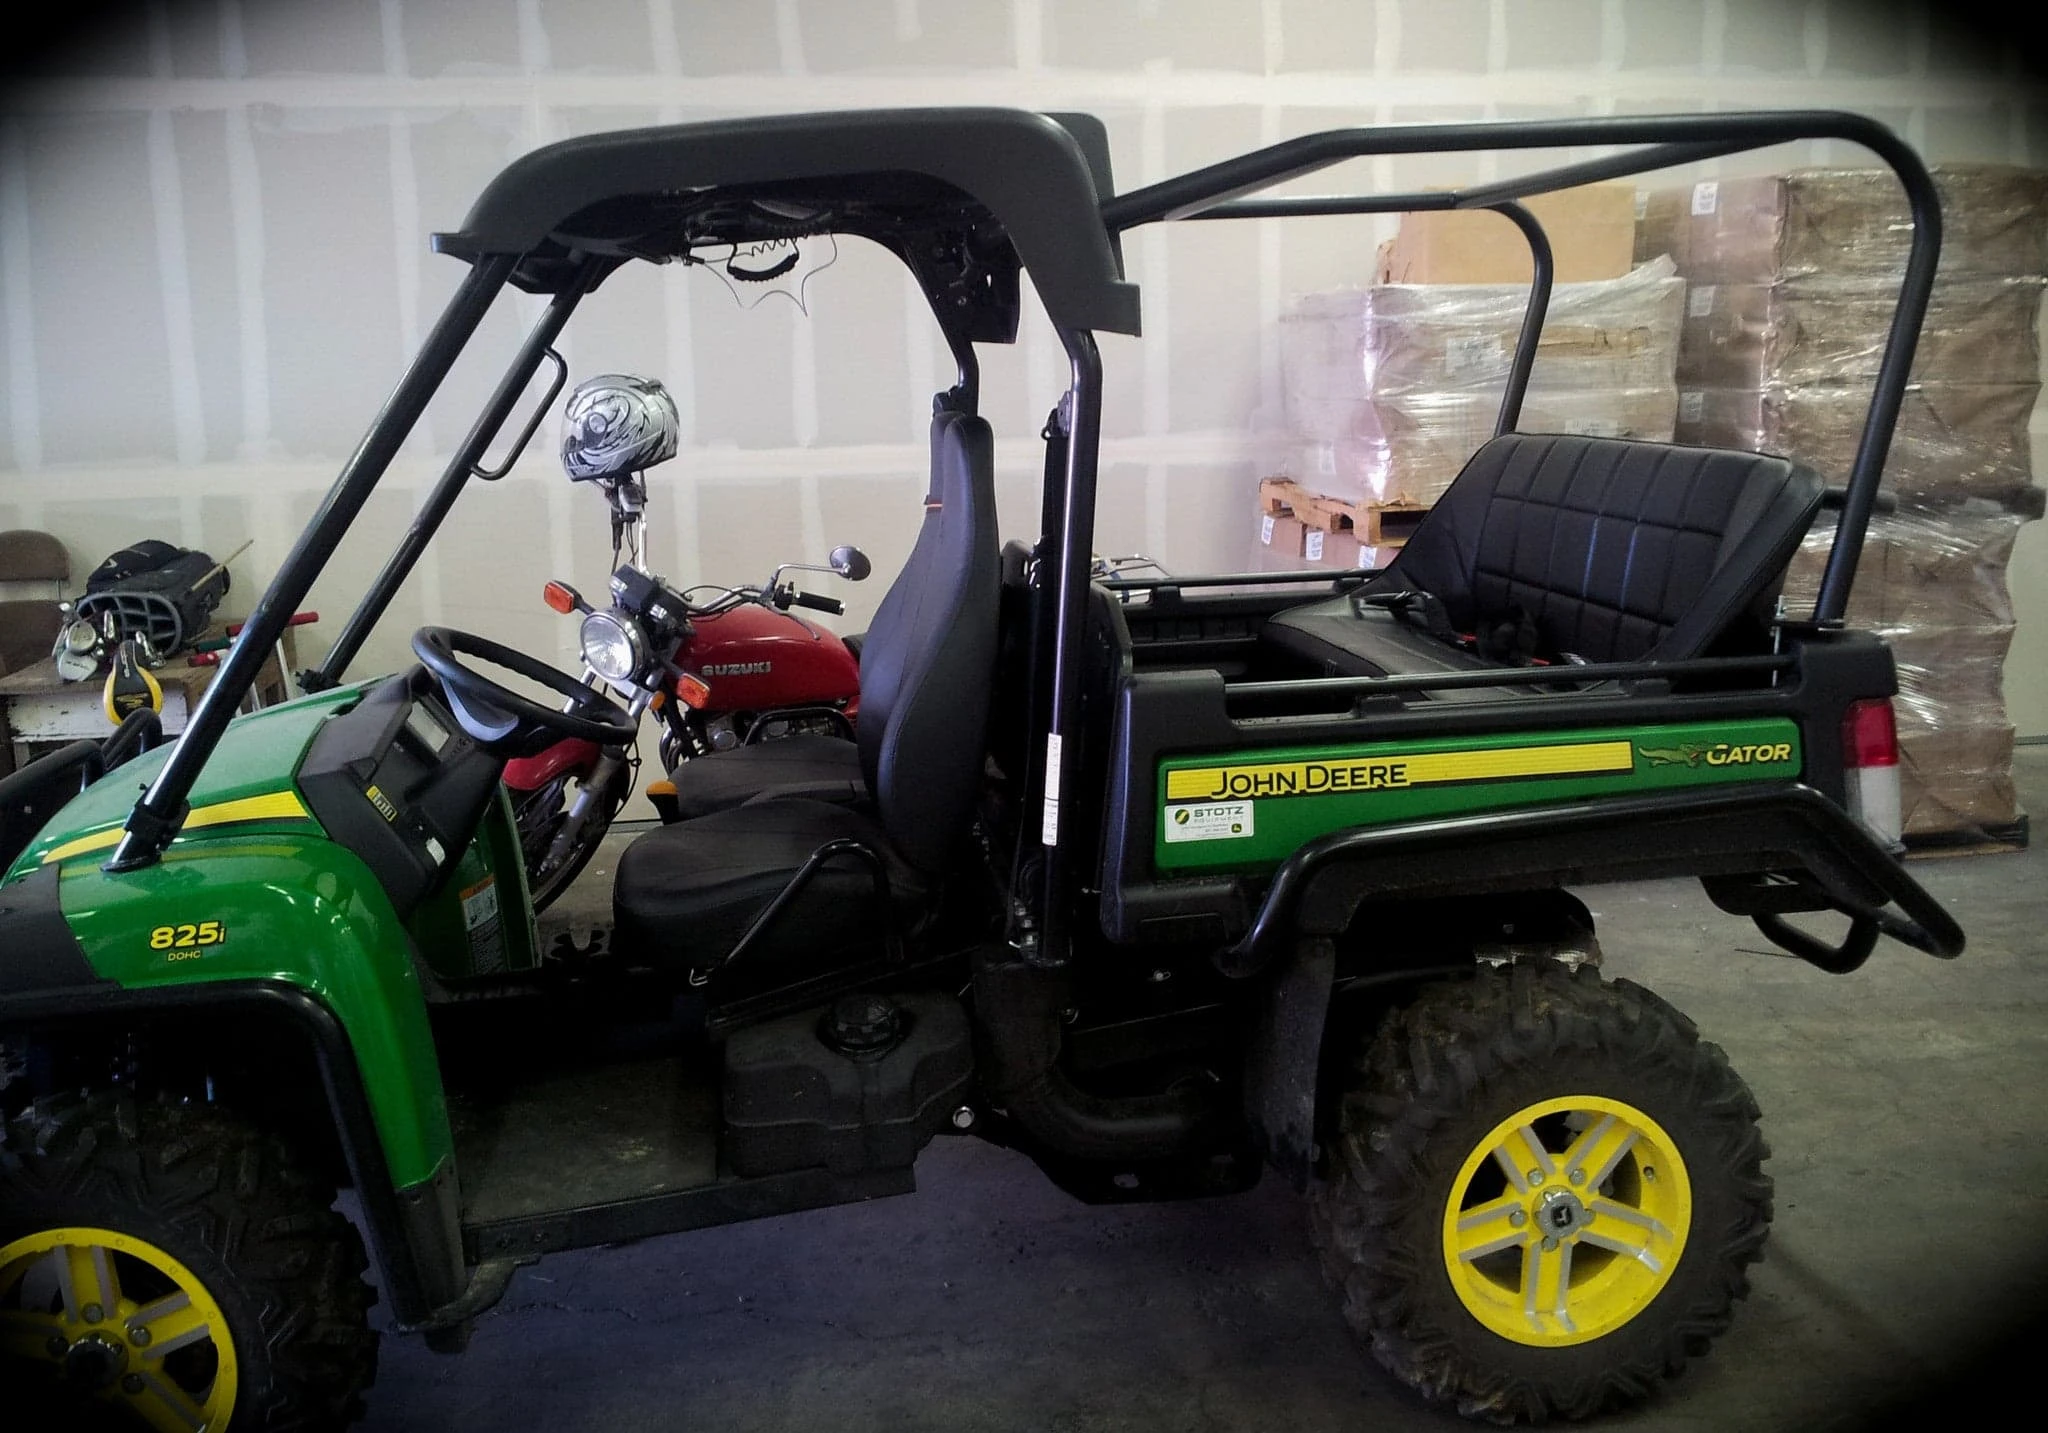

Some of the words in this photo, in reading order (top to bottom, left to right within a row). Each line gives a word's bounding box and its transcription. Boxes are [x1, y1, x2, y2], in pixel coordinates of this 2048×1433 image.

[702, 661, 771, 677] SUZUKI
[1706, 743, 1791, 765] GATOR
[1211, 769, 1297, 797] JOHN
[1305, 763, 1408, 790] DEERE
[1193, 806, 1244, 818] STOTZ
[150, 921, 225, 949] 825i
[167, 950, 201, 962] DOHC
